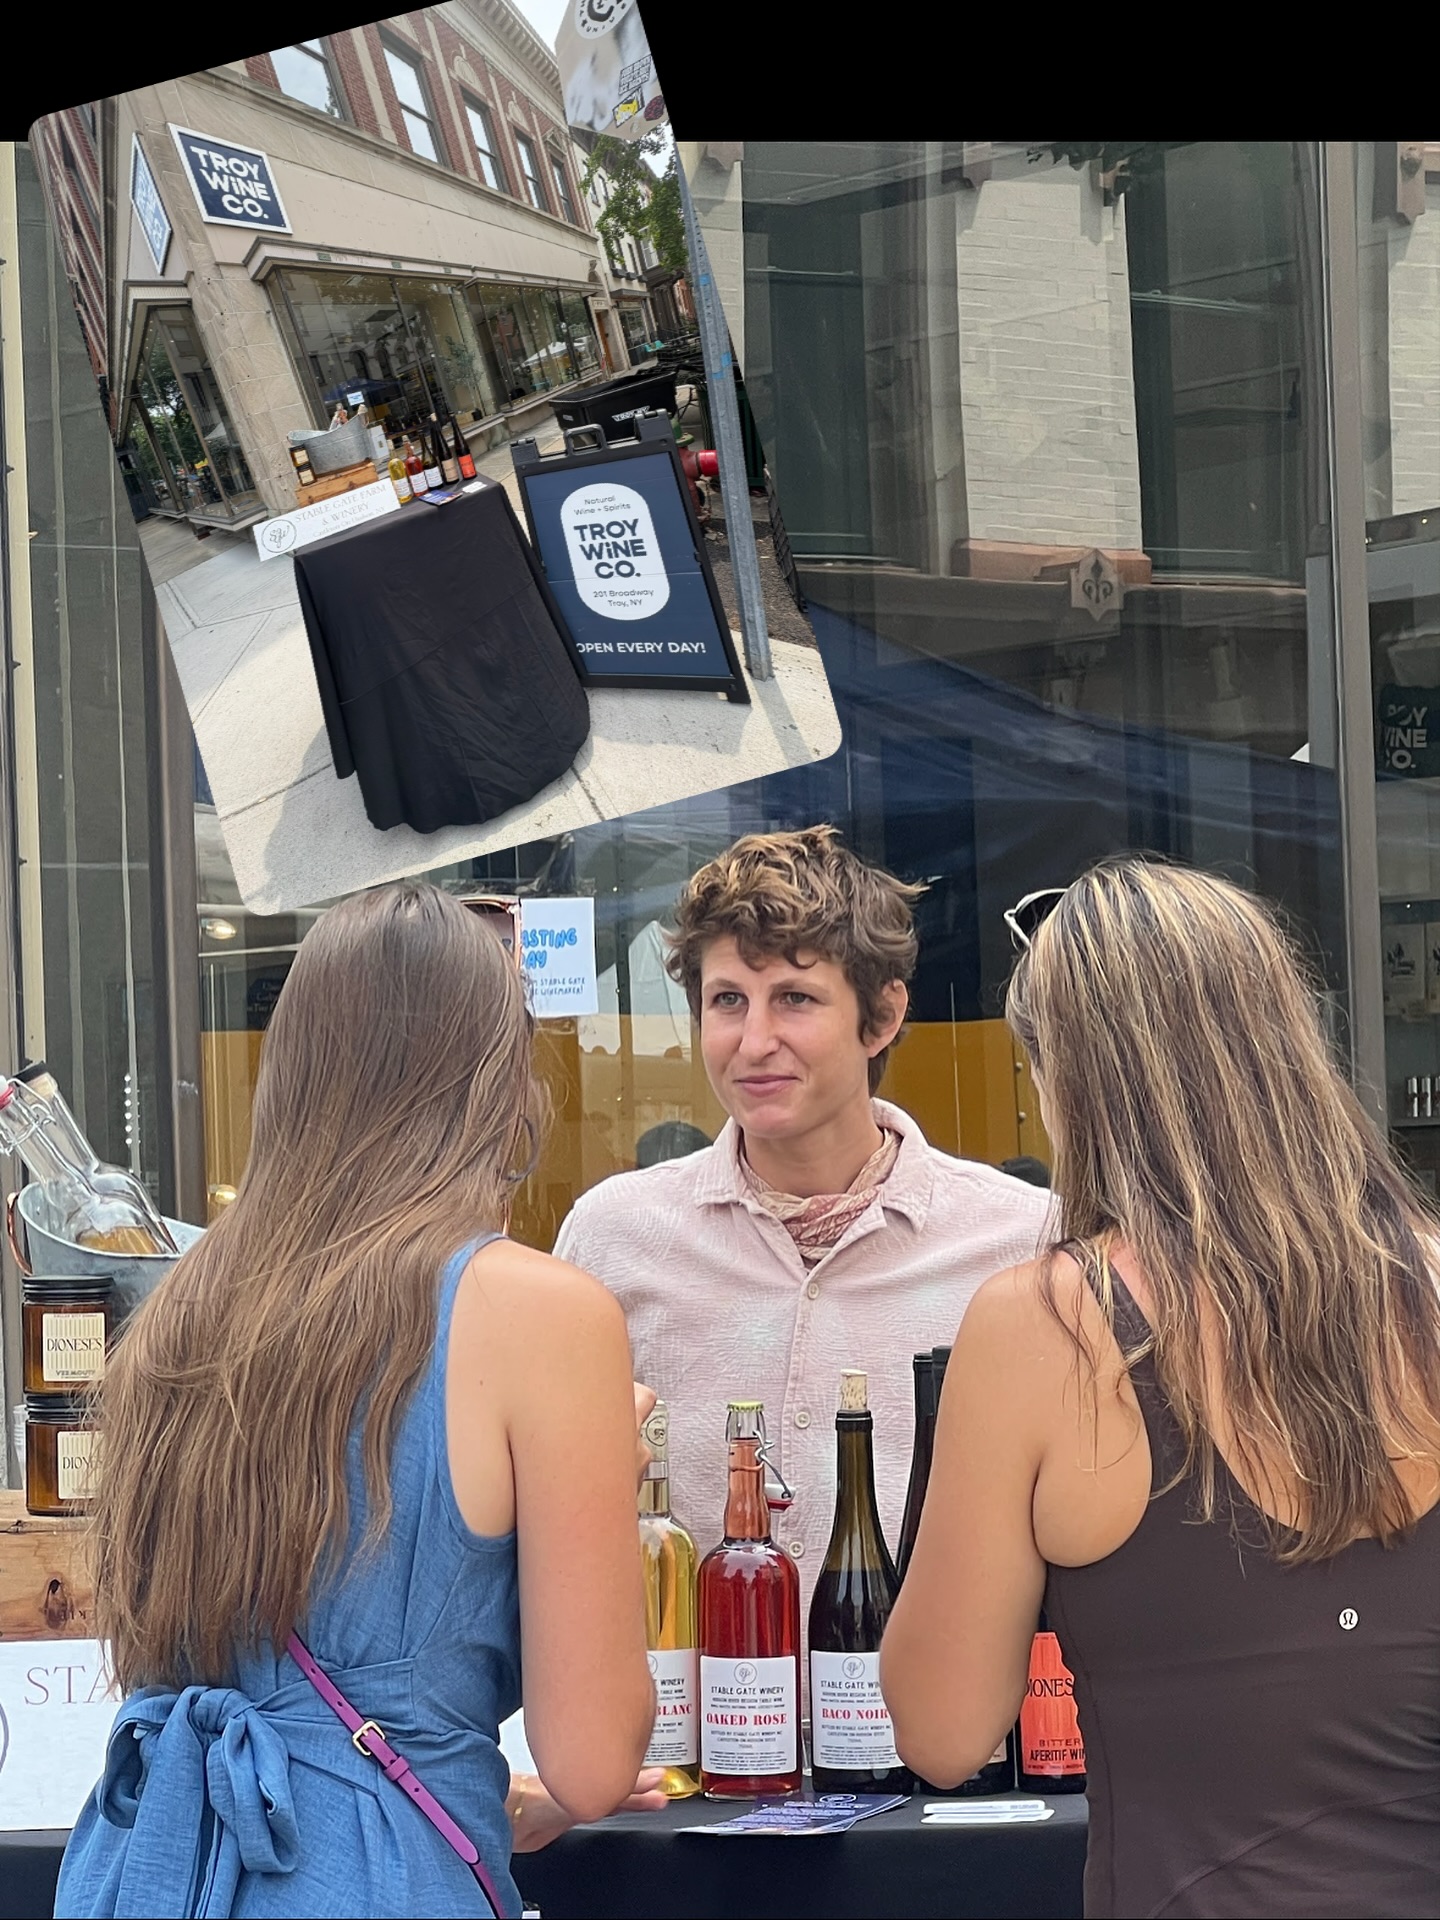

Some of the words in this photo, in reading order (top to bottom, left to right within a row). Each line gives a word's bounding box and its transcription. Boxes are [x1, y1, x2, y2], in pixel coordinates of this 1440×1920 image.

[190, 146, 259, 180] TROY
[222, 194, 269, 219] CO.
[295, 502, 332, 523] STABLE
[333, 495, 358, 510] GATE
[359, 484, 387, 502] FARM
[584, 495, 616, 505] Natural
[331, 501, 370, 521] WINERY
[574, 508, 596, 516] Wine
[603, 503, 631, 513] Spirits
[573, 518, 639, 541] TROY
[595, 560, 641, 579] CO.
[593, 590, 608, 598] 201
[609, 589, 655, 597] Broadway
[607, 600, 630, 608] Troy,
[576, 642, 614, 653] OPEN
[617, 642, 664, 653] EVERY
[668, 642, 706, 653] DAY!
[522, 928, 577, 949] ASTING
[522, 949, 547, 969] AY
[568, 976, 585, 985] GATE
[47, 1337, 103, 1352] DIONESES
[24, 1665, 121, 1706] STA
[660, 1678, 685, 1687] WINERY
[820, 1680, 842, 1690] STABLE
[844, 1681, 865, 1690] GATE
[711, 1686, 734, 1695] STABLE
[736, 1687, 756, 1696] GATE
[759, 1686, 785, 1695] WINERY
[706, 1713, 748, 1726] OAKED
[753, 1713, 788, 1726] ROSE
[821, 1707, 851, 1720] BACO
[856, 1708, 889, 1721] NOIR
[1039, 1738, 1081, 1748] BITTER
[1030, 1749, 1068, 1762] APERITIF
